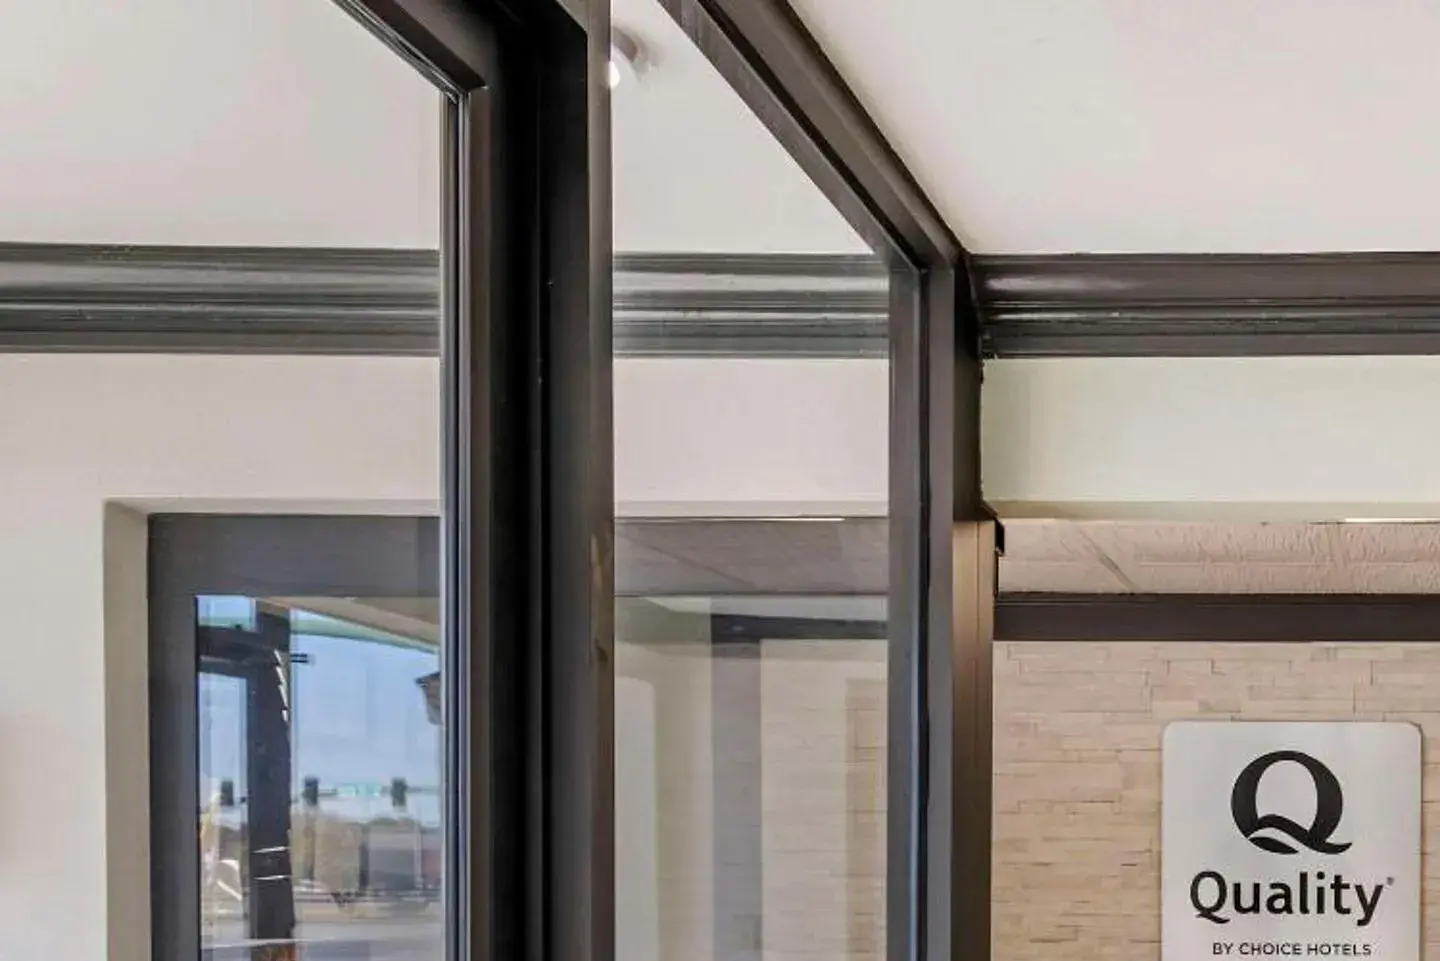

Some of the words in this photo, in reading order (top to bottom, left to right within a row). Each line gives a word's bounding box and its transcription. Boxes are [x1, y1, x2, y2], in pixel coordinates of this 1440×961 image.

[1190, 870, 1385, 927] Quality
[1212, 942, 1234, 956] BY
[1238, 942, 1303, 956] CHOICE
[1306, 943, 1372, 957] HOTELS
